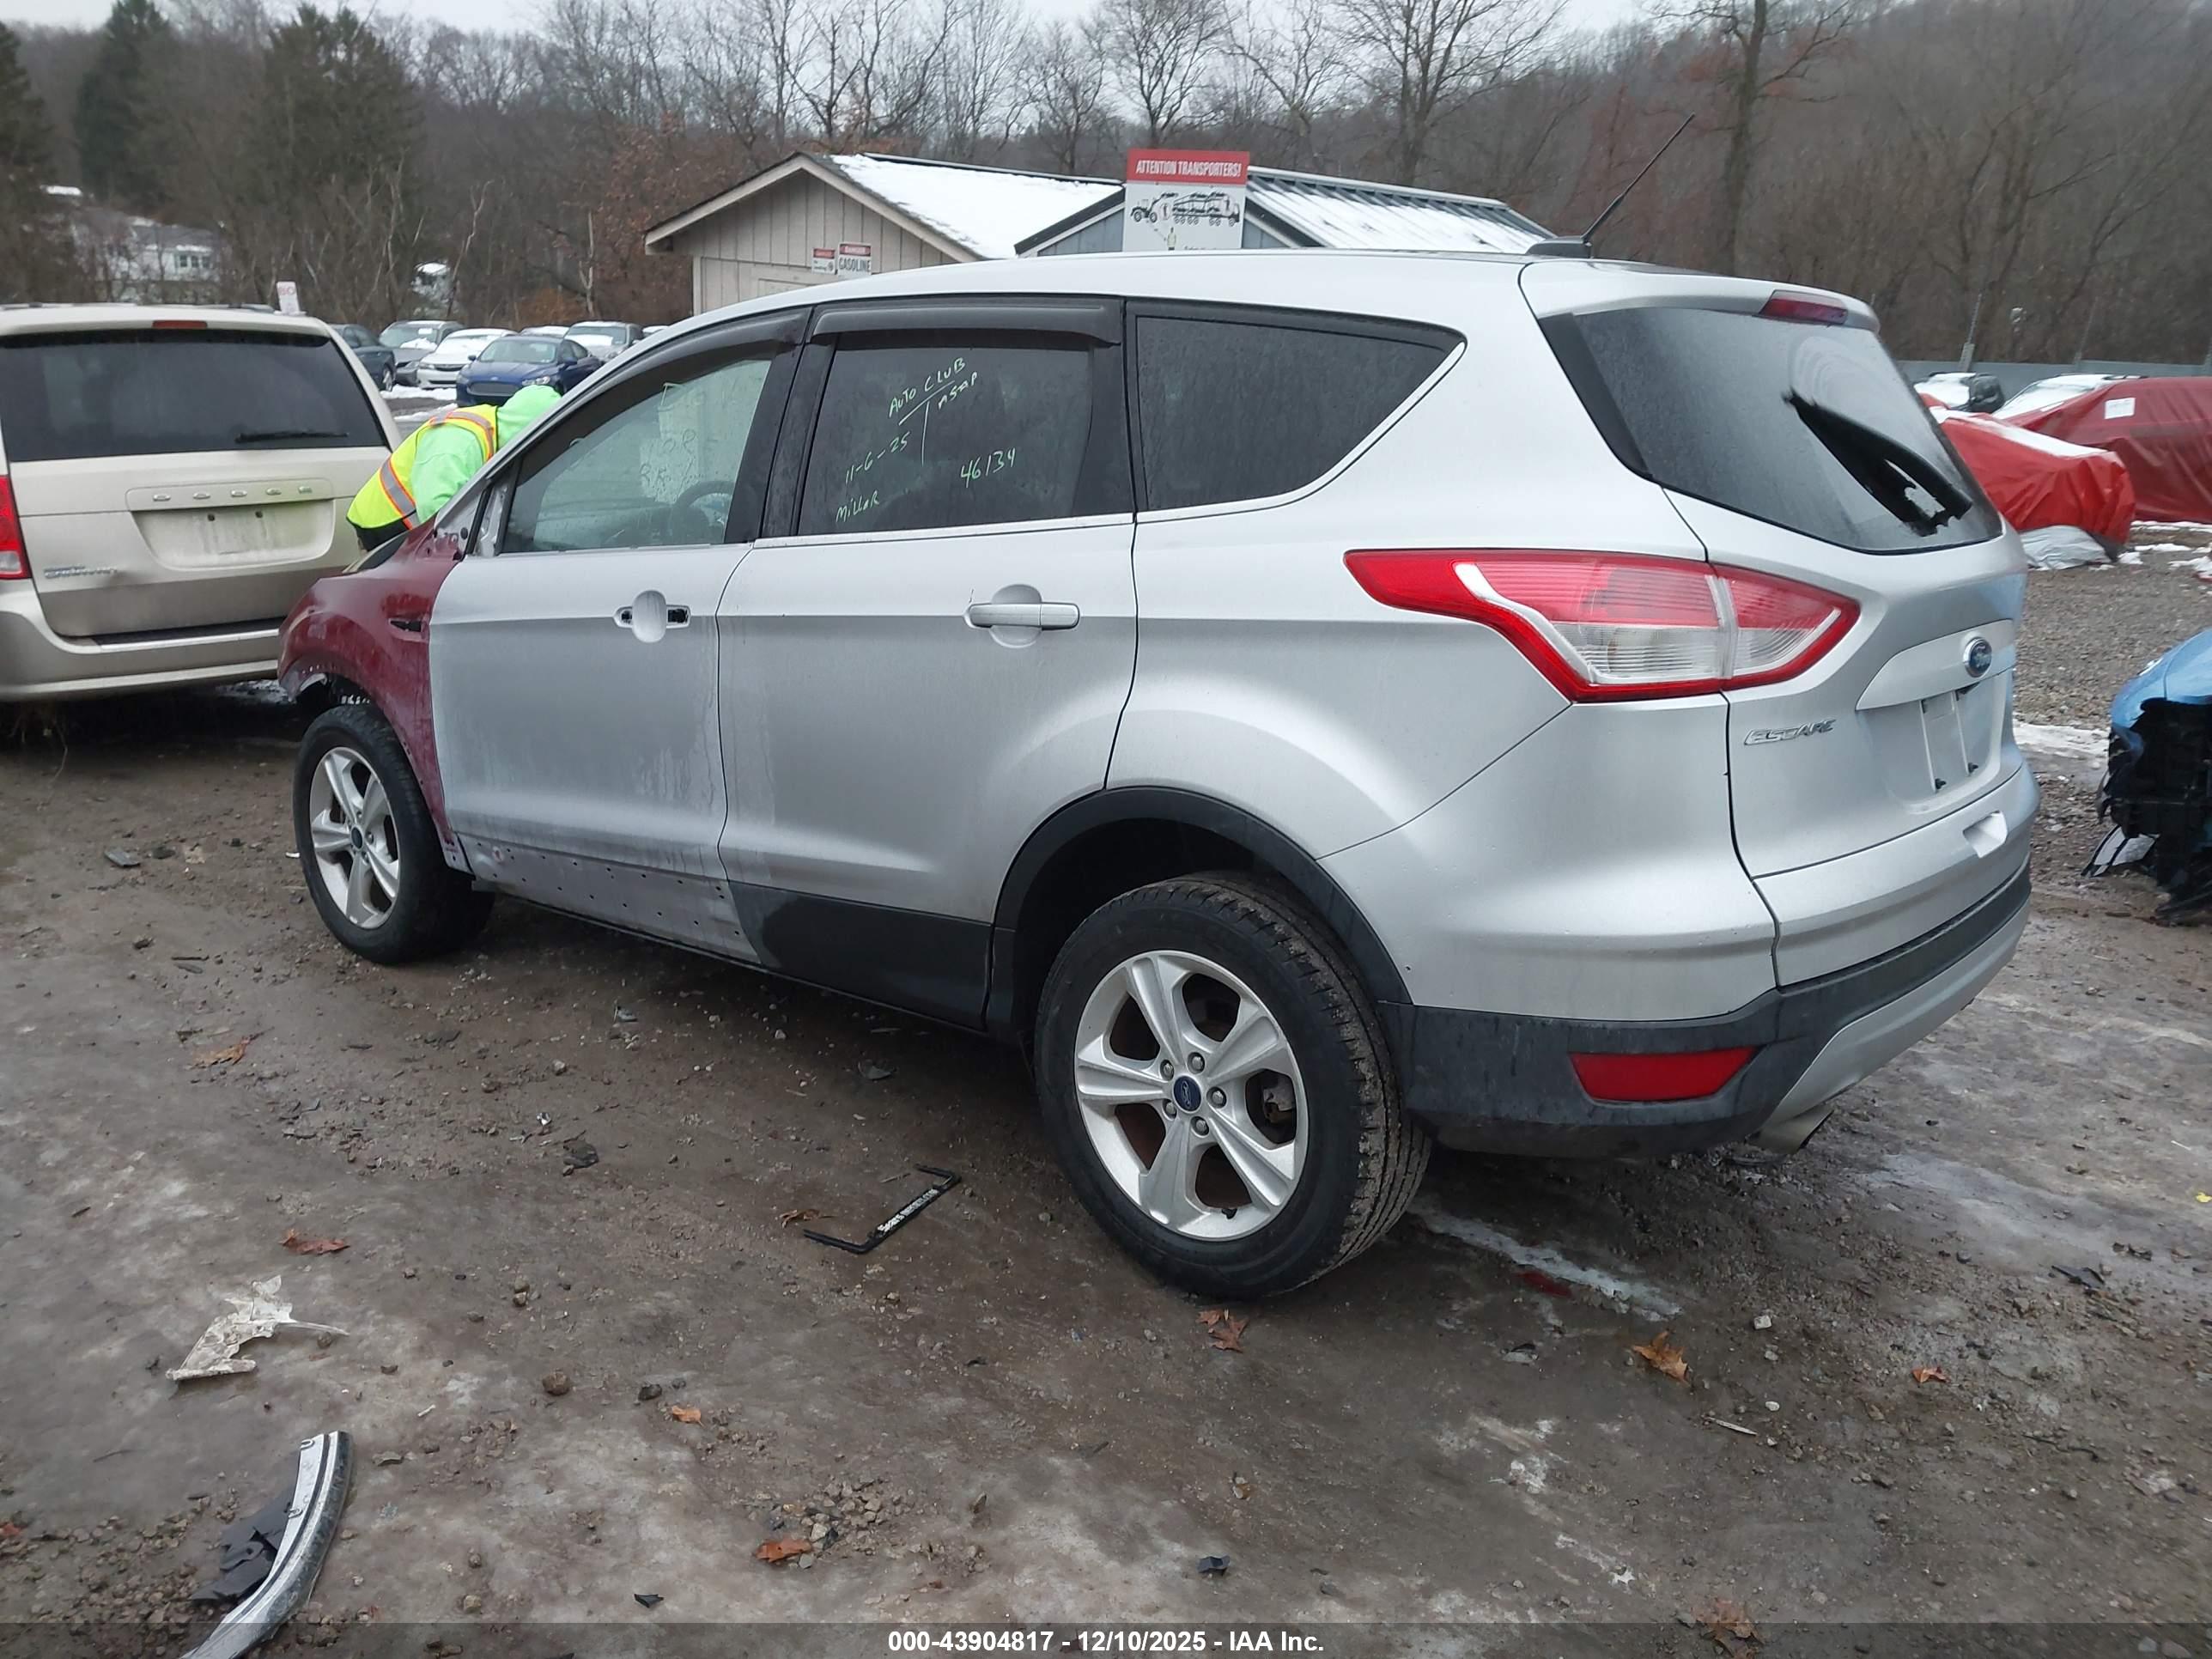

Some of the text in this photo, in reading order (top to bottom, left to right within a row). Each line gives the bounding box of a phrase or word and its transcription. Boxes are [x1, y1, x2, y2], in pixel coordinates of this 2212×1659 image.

[1136, 160, 1242, 177] ATTENTION TRANSPORTERS!
[839, 258, 871, 272] GASOLINE
[925, 357, 965, 392] CLUB
[960, 447, 1016, 488] 46134
